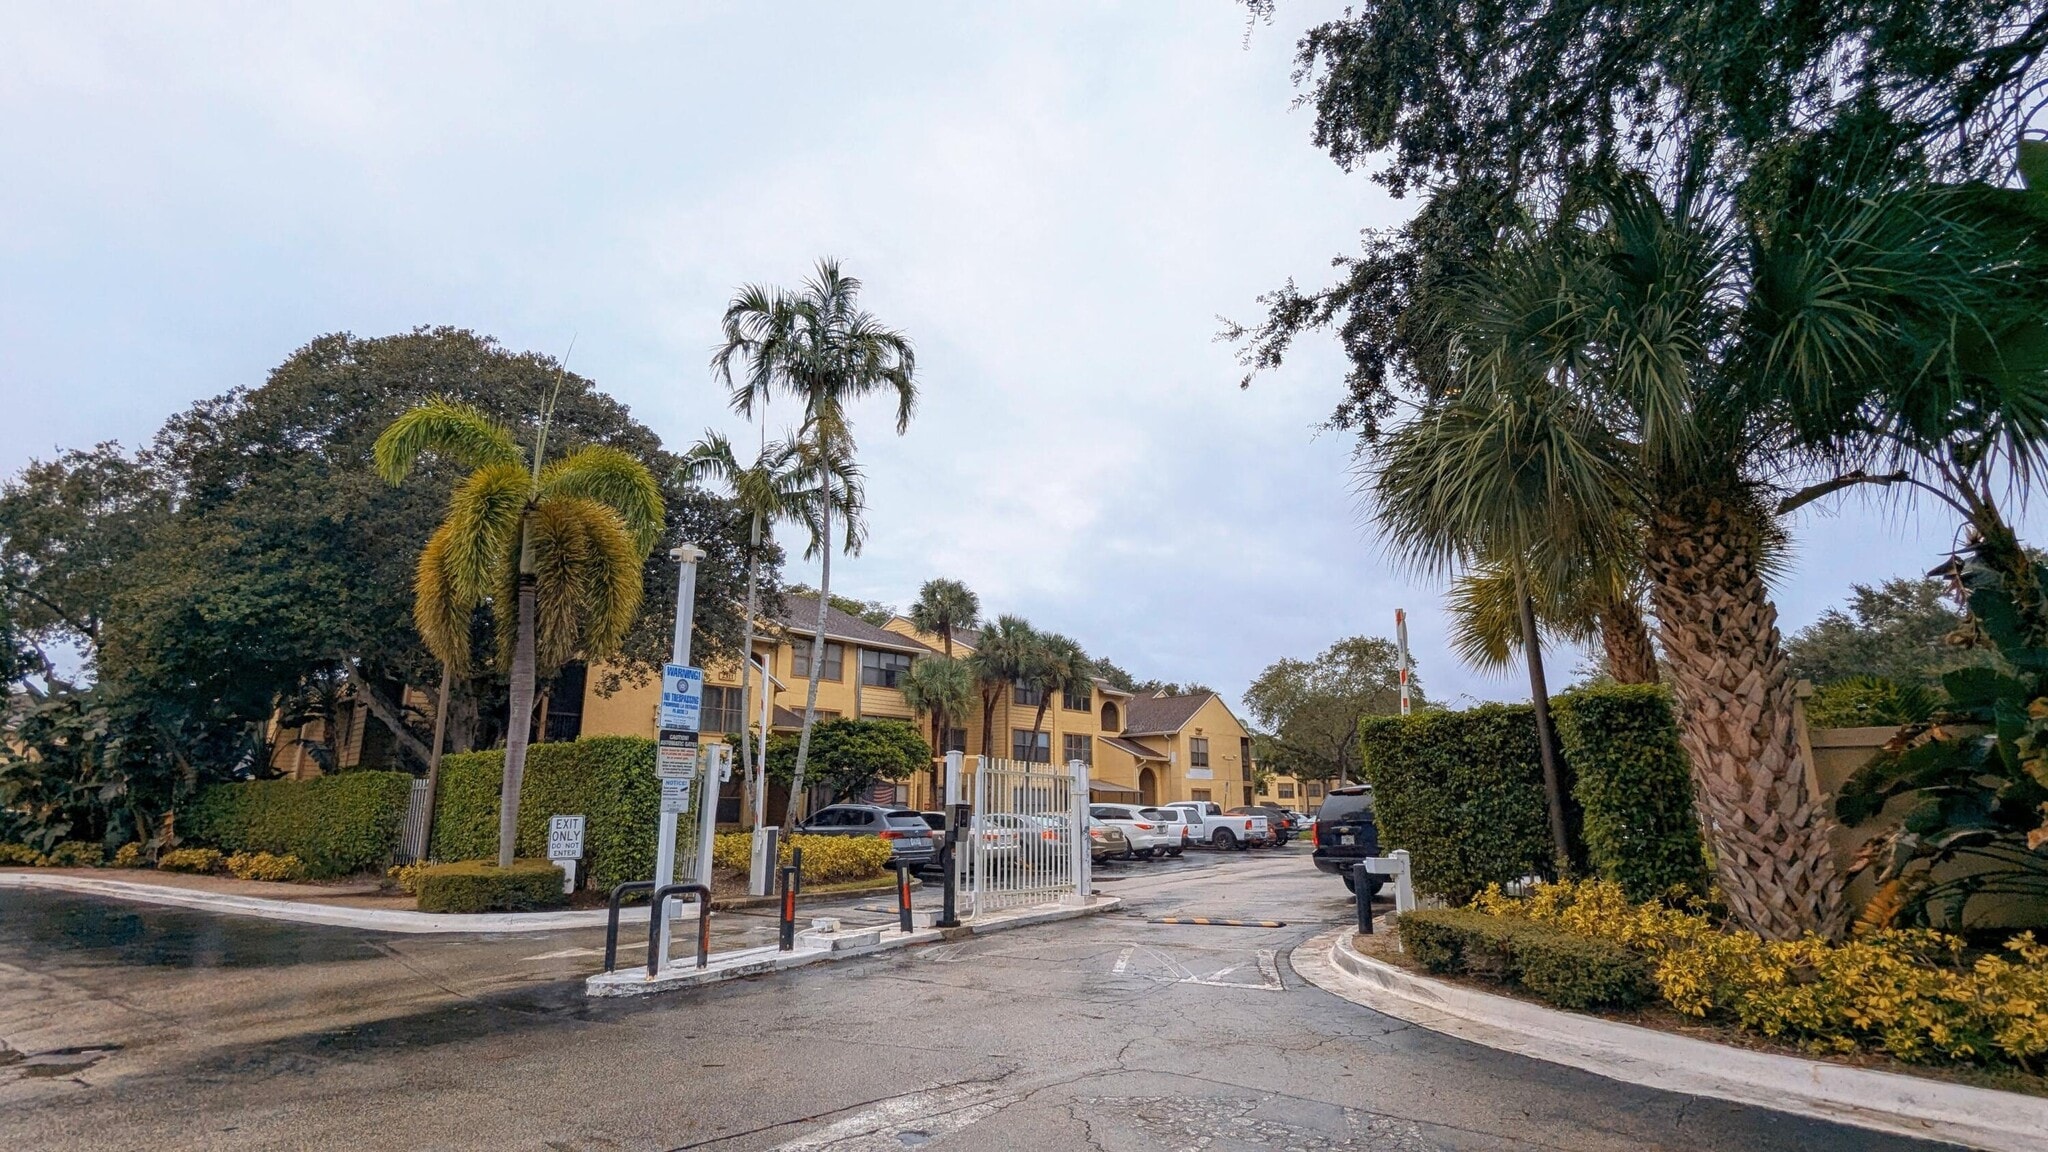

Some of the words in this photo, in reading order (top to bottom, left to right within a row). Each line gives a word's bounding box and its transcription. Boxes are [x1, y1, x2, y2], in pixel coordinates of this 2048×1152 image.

[667, 666, 700, 680] WARNING!
[664, 692, 670, 701] NO
[556, 819, 579, 829] EXIT
[552, 831, 581, 841] ONLY
